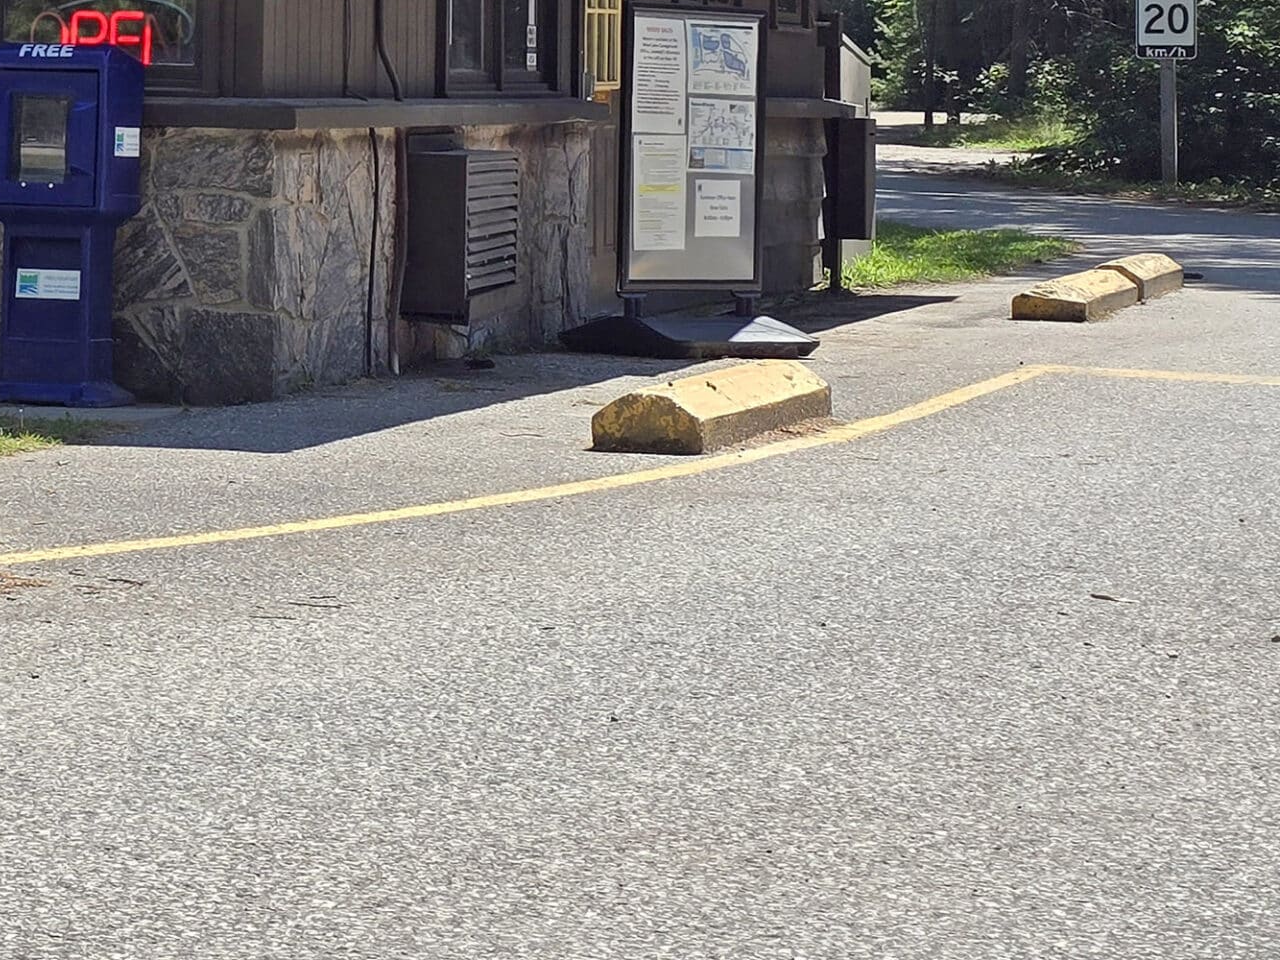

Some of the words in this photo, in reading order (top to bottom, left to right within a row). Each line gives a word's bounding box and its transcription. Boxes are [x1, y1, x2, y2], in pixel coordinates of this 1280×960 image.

[1144, 3, 1189, 34] 20
[19, 44, 75, 57] FREE
[1146, 46, 1187, 57] km/h
